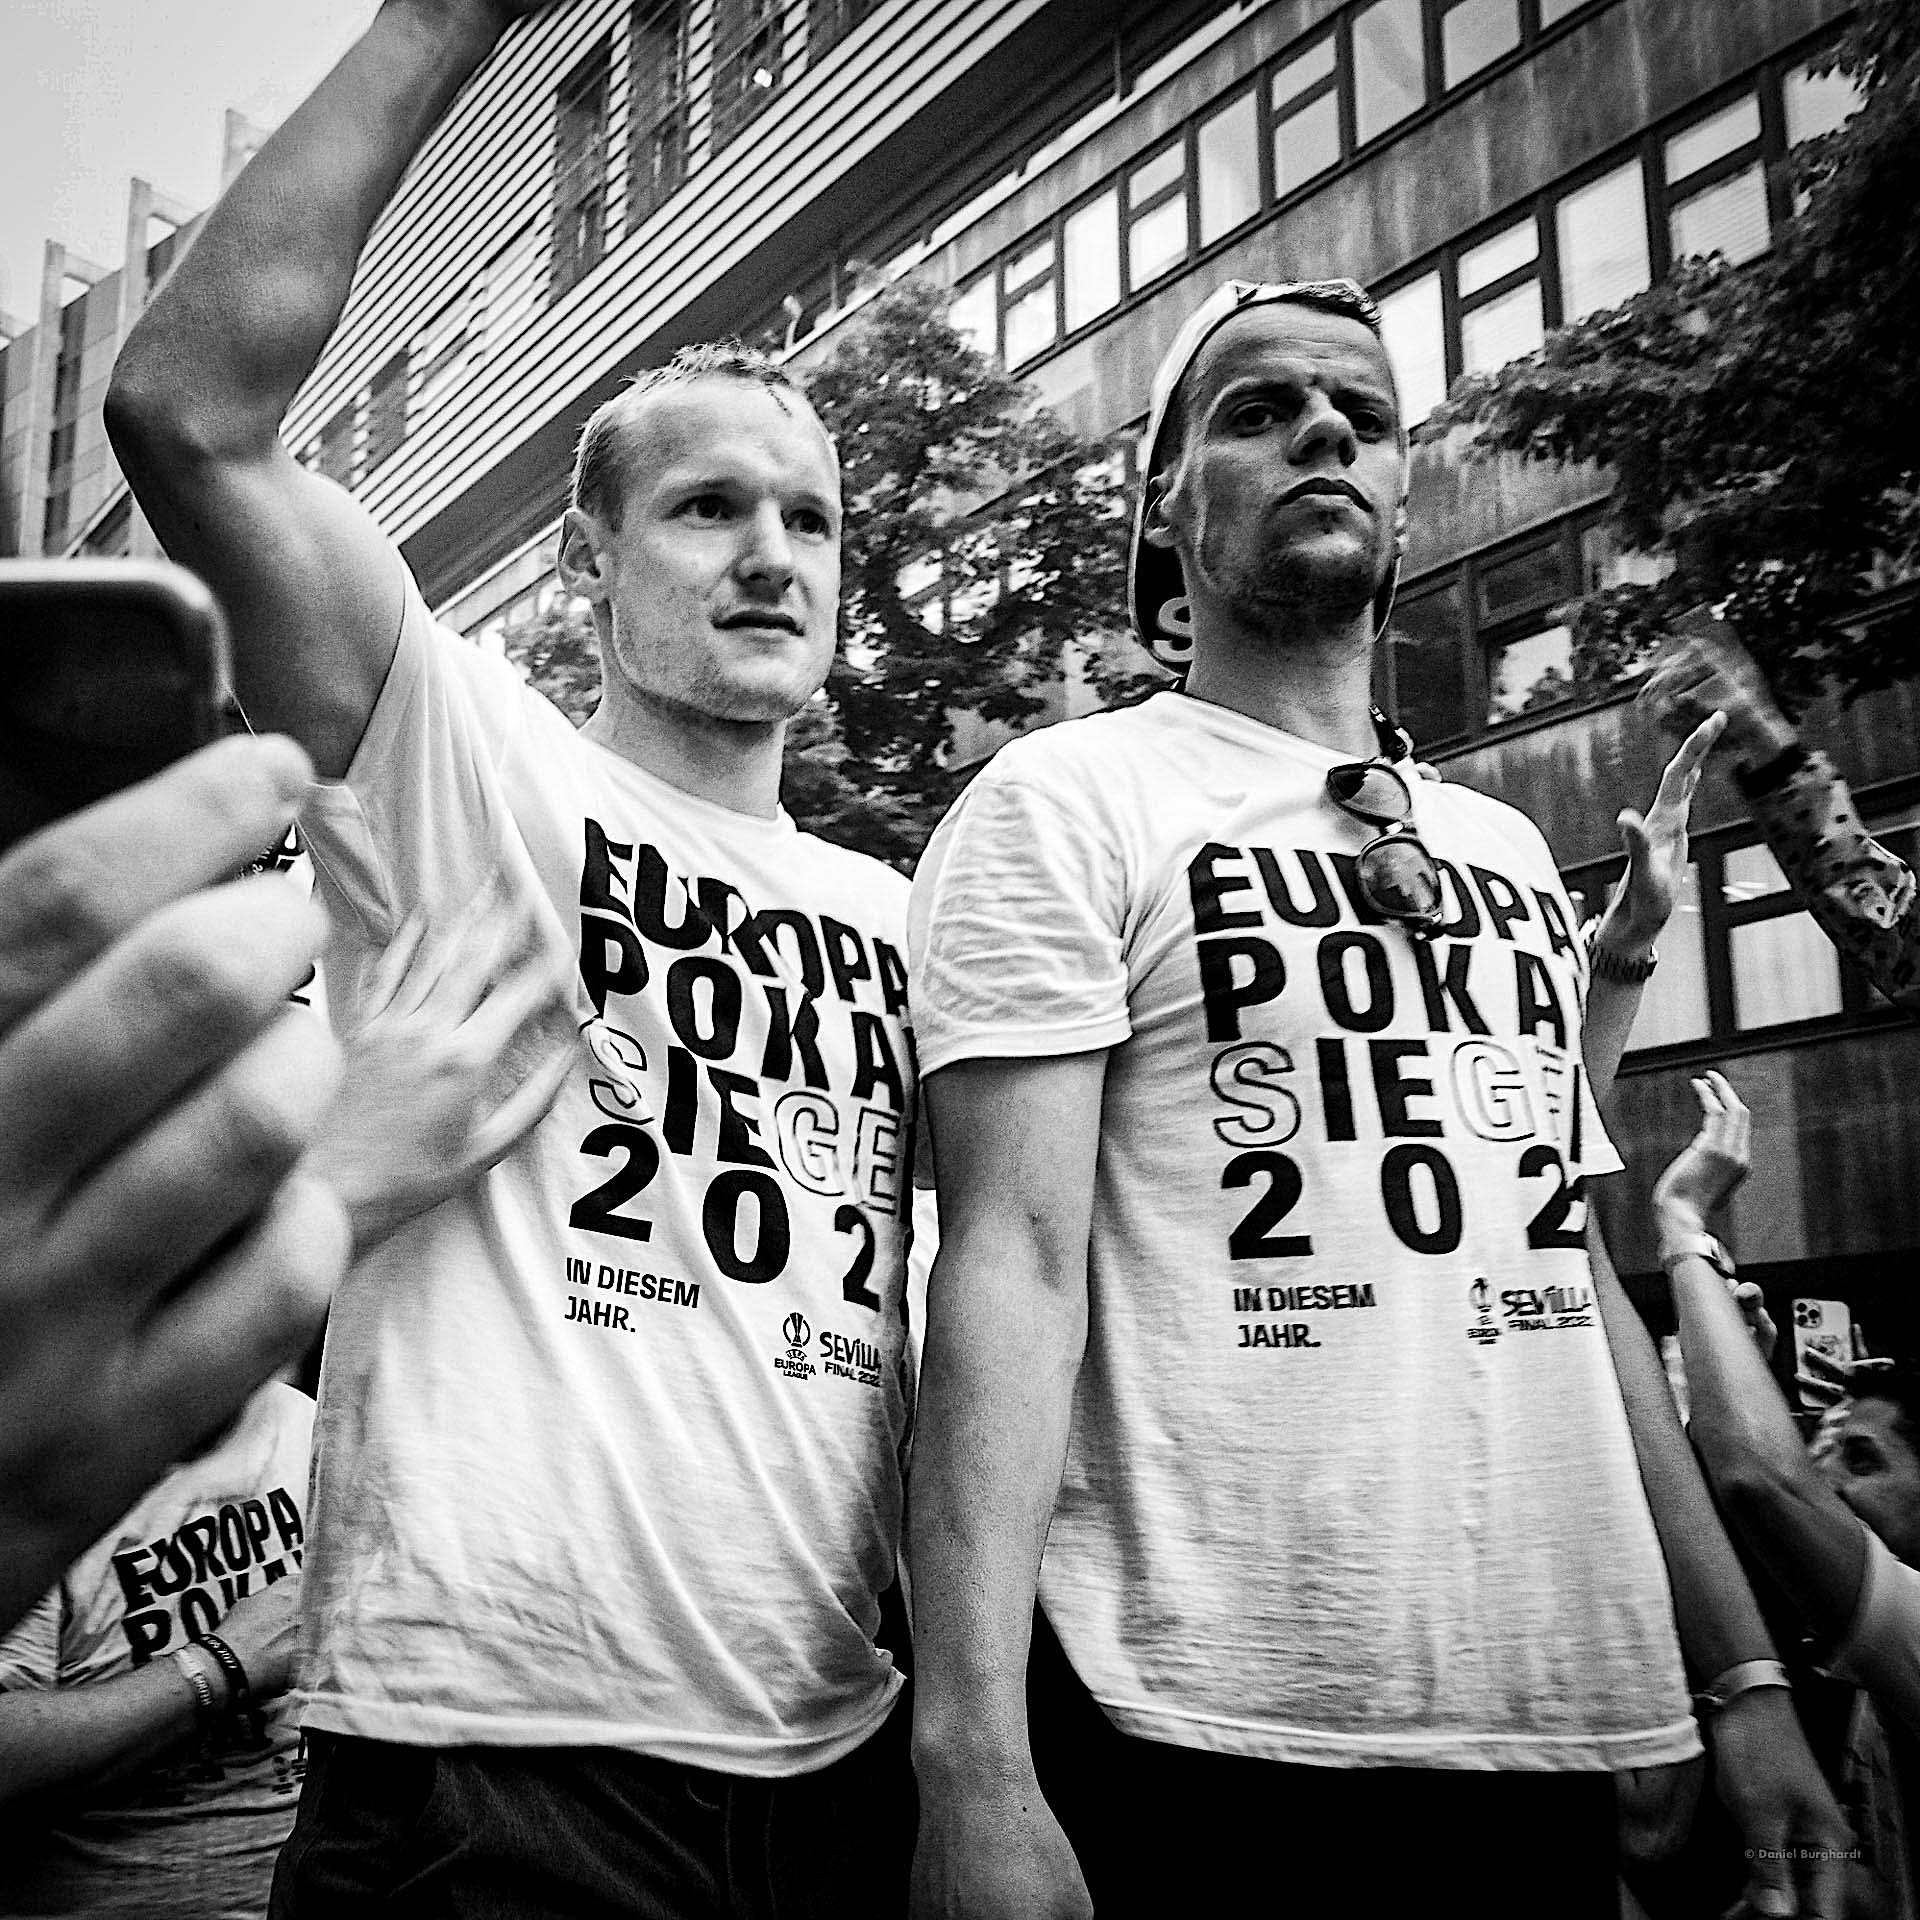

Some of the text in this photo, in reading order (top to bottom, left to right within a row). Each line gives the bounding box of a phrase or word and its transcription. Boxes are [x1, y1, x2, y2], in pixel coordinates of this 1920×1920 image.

[579, 817, 909, 1017] EUROPA
[565, 1257, 700, 1309] IN DIESEM
[1233, 1283, 1377, 1312] IN DIESEM
[564, 1296, 636, 1333] JAHR.
[1238, 1324, 1322, 1348] JAHR.
[774, 1358, 816, 1375] EUROPA
[111, 1487, 304, 1617] EUROPA
